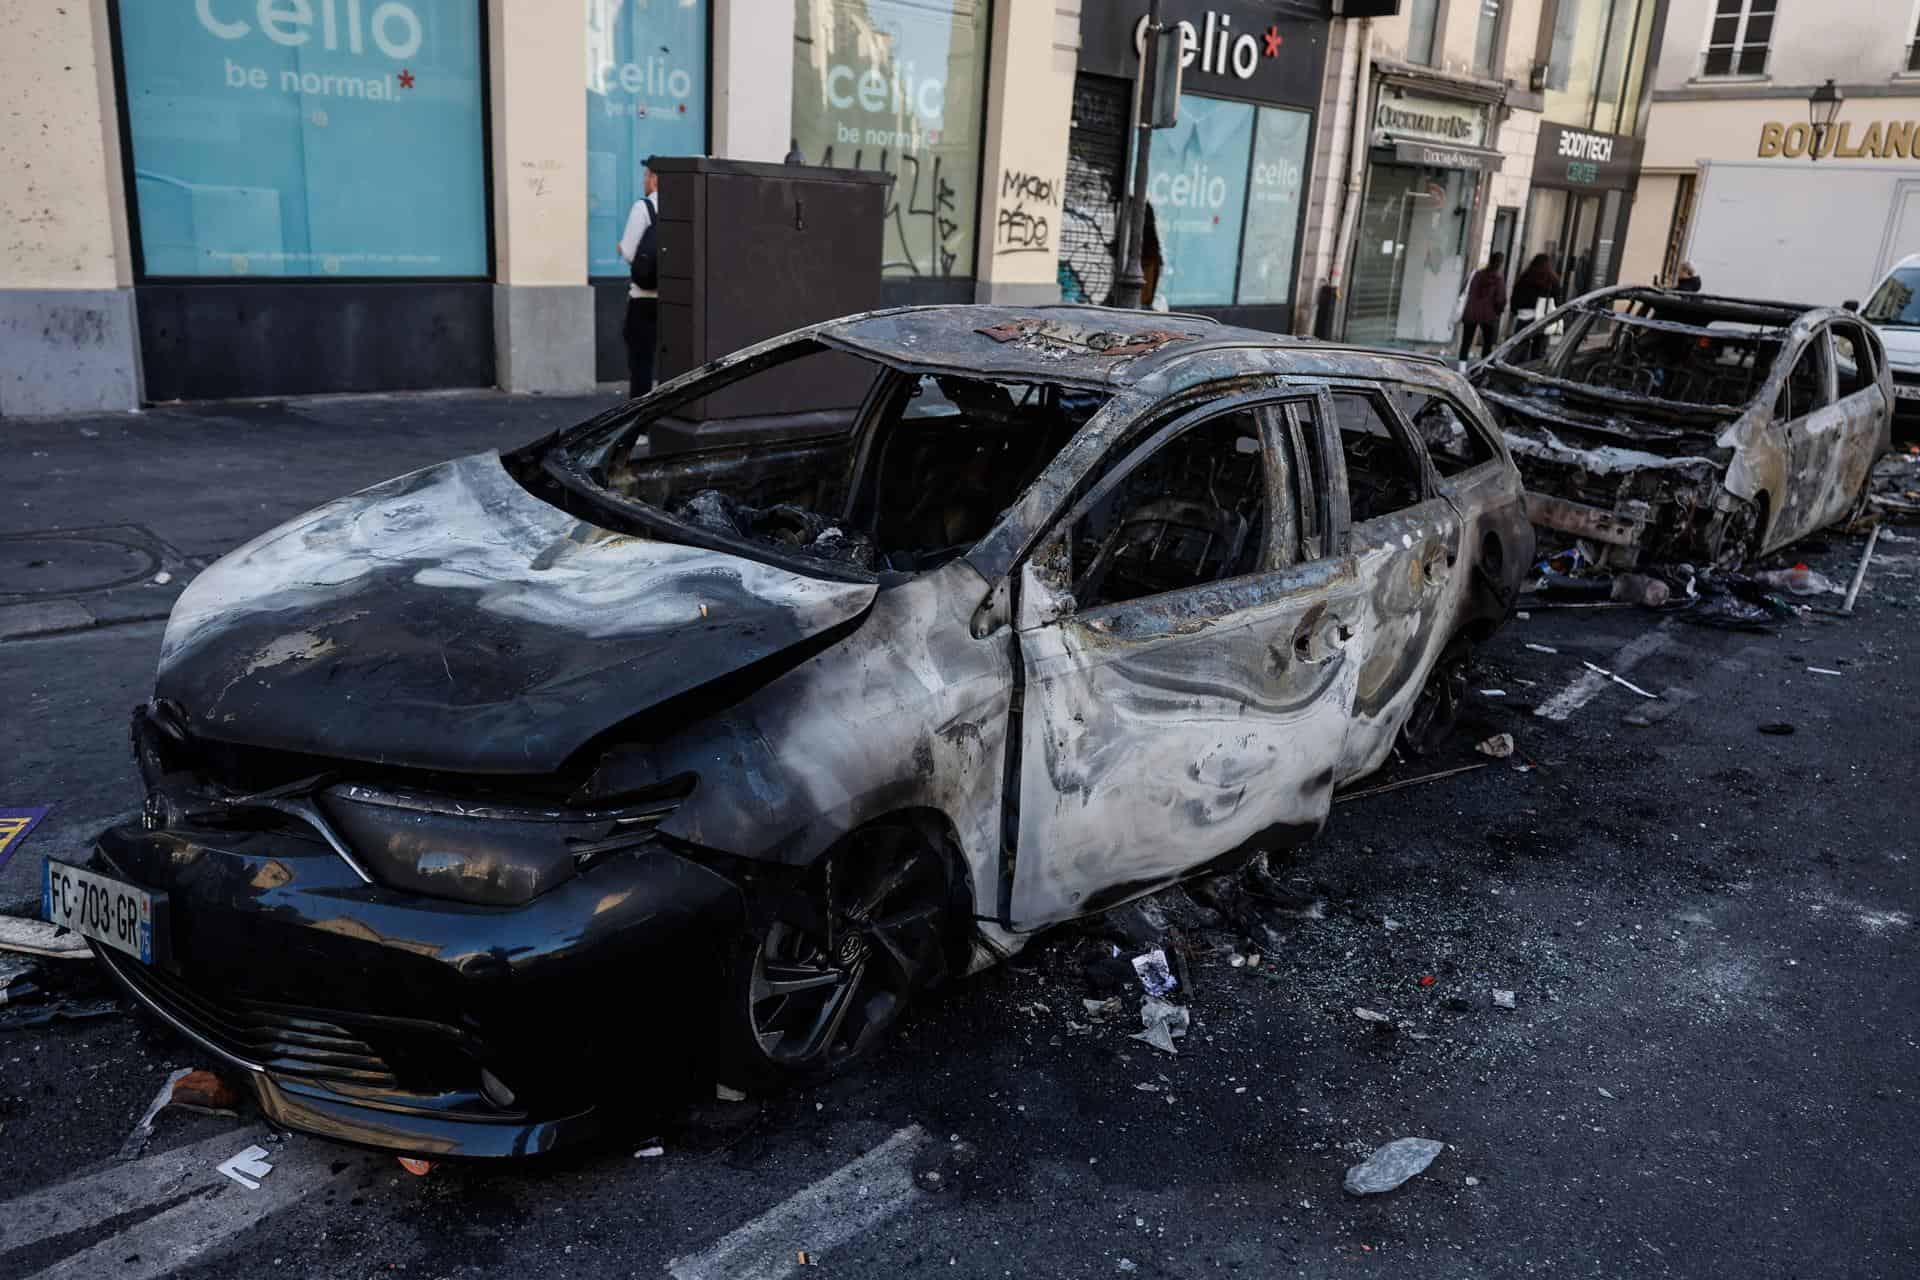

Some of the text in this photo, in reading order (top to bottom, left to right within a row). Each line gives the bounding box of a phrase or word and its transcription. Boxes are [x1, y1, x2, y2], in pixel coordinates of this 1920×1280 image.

[224, 58, 268, 89] be
[598, 56, 691, 98] celio
[837, 120, 860, 144] be
[1151, 163, 1226, 209] celio
[997, 201, 1048, 246] PÉDO
